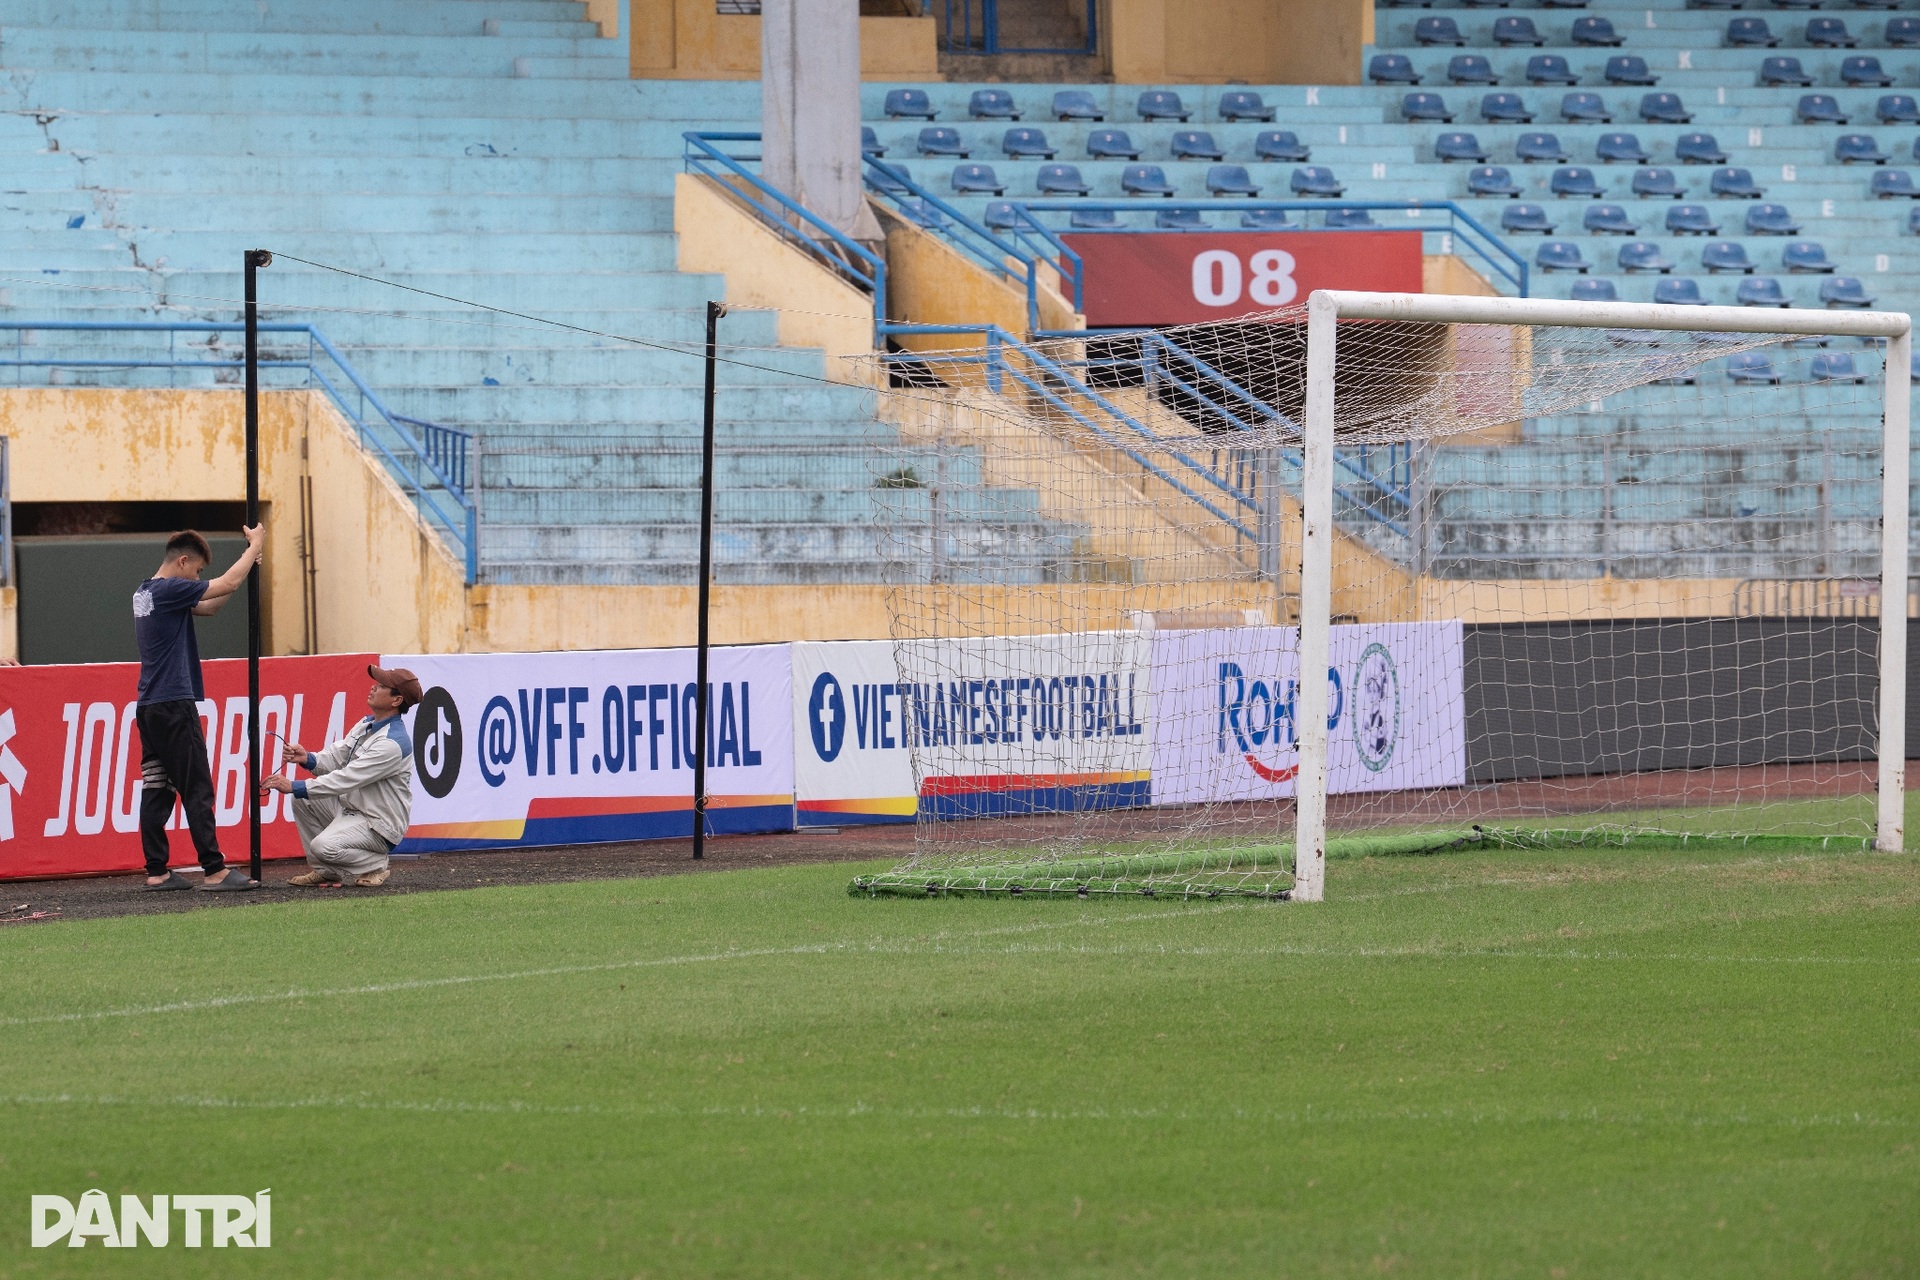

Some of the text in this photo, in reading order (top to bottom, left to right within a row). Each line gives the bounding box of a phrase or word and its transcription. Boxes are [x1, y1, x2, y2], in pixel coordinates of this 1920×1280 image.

[1645, 10, 1657, 28] L
[1678, 50, 1692, 68] K
[1305, 87, 1319, 105] K
[1748, 128, 1762, 146] H
[1822, 200, 1835, 217] E
[1192, 249, 1298, 306] 08
[852, 673, 1143, 750] VIETNAMESEFOOTBALL
[1218, 662, 1344, 754] ROHO
[477, 681, 762, 788] @VFF.OFFICIAL
